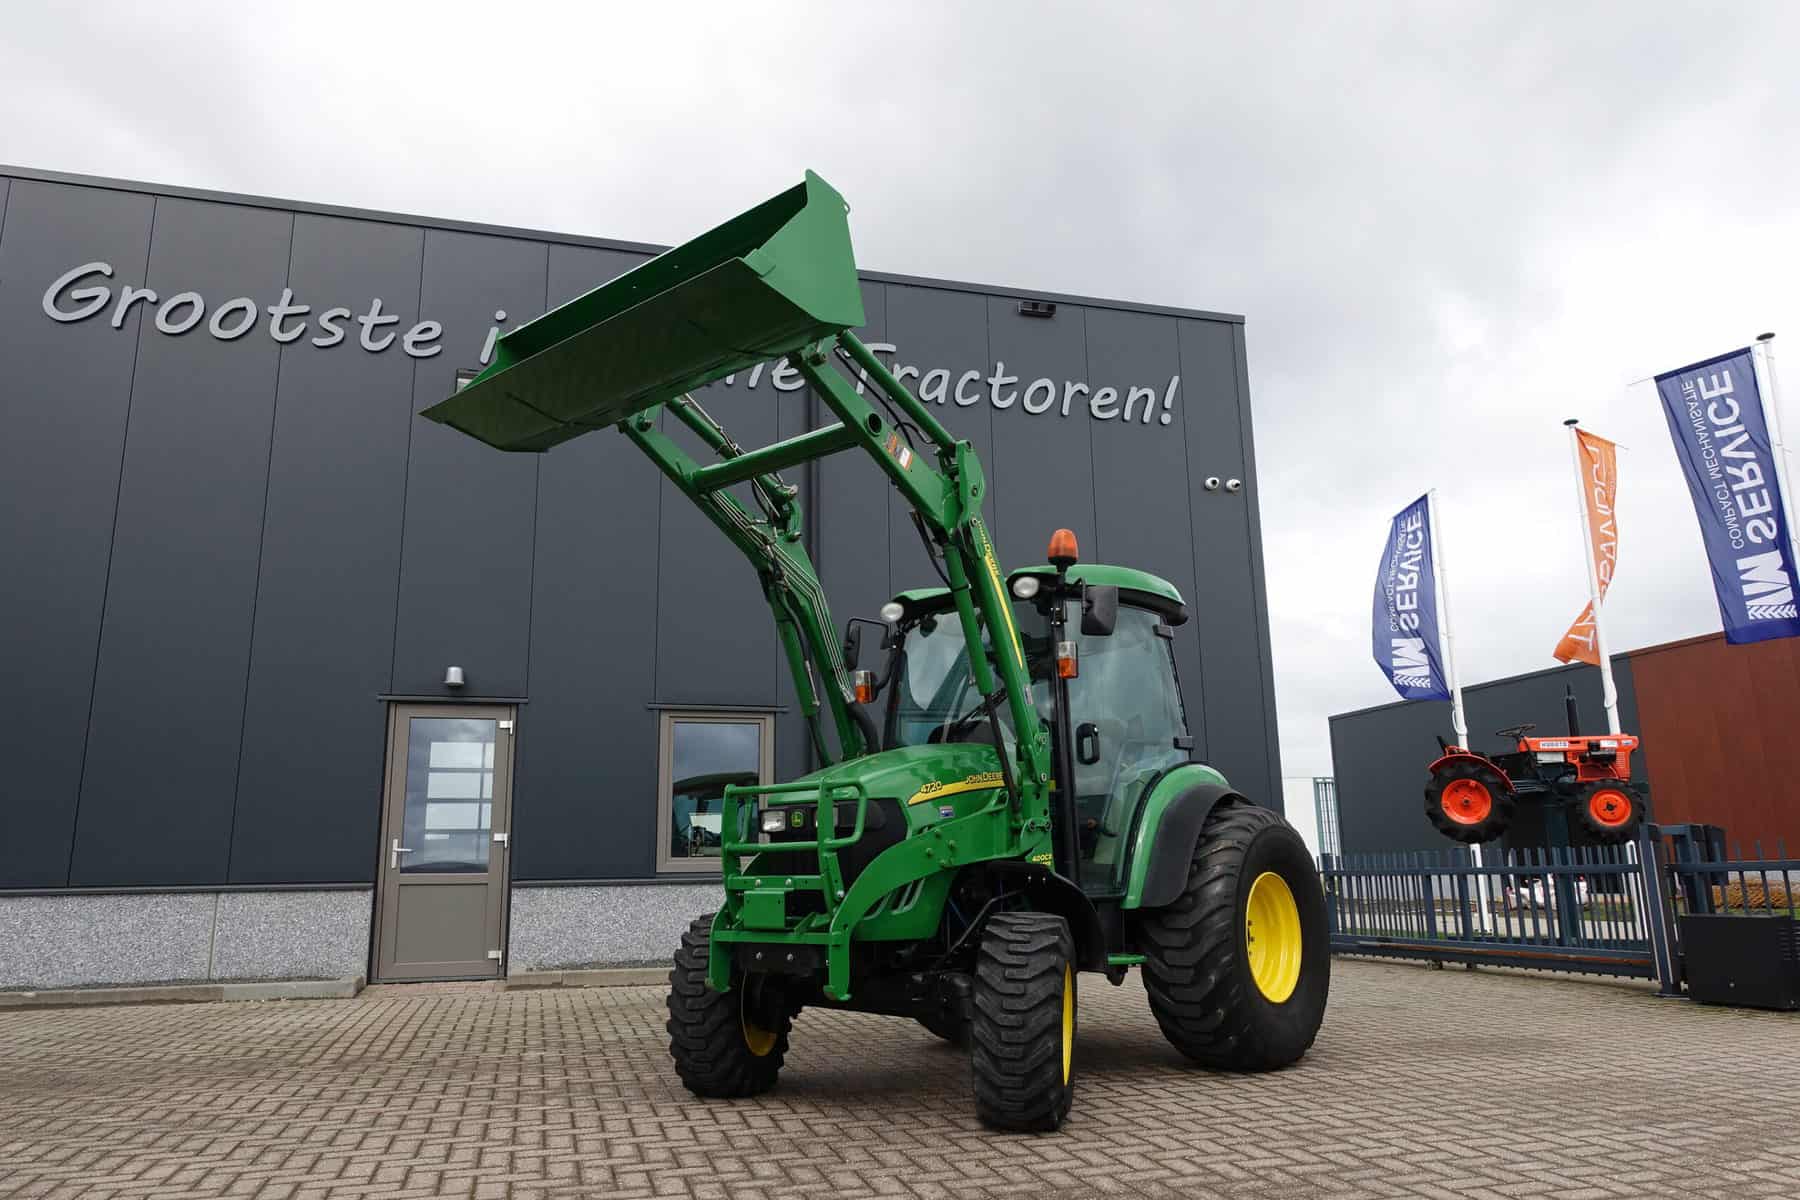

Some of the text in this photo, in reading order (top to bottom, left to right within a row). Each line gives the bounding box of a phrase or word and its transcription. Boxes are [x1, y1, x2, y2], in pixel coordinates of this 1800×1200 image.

[41, 261, 443, 360] Grootste
[845, 343, 1180, 425] Tractoren!
[920, 780, 943, 793] 4720
